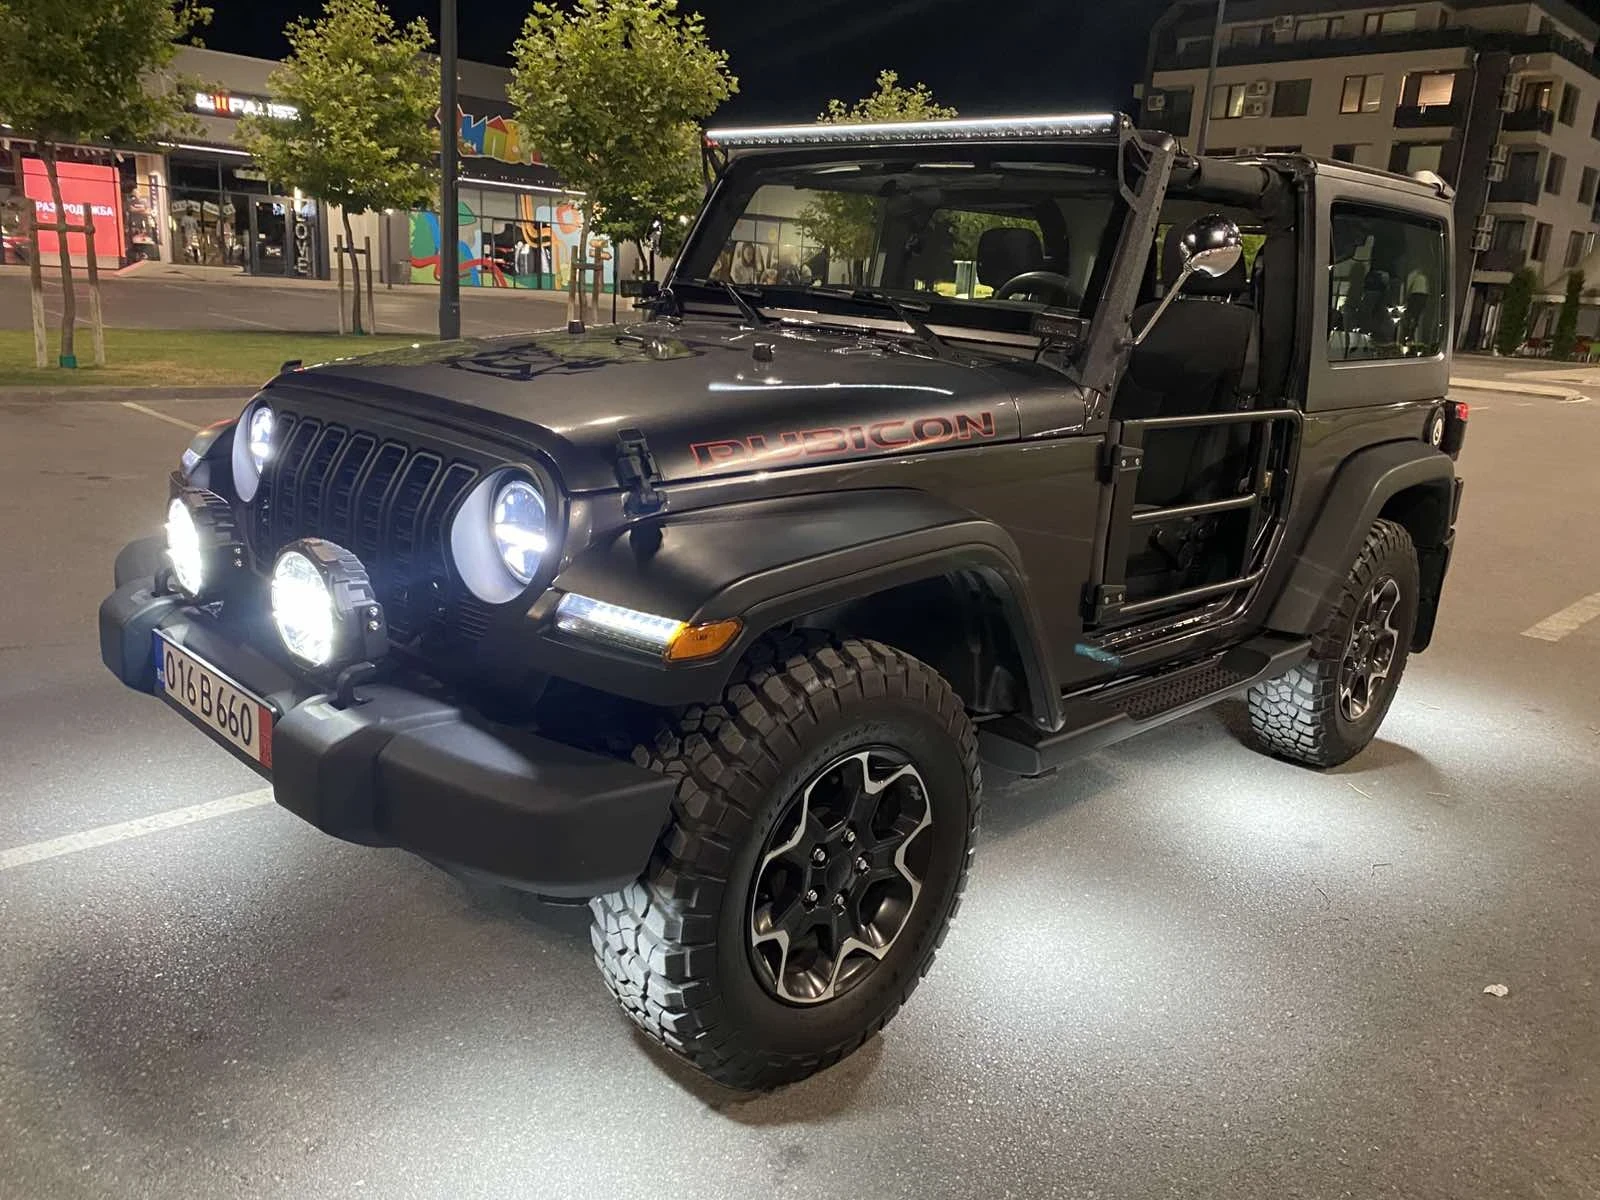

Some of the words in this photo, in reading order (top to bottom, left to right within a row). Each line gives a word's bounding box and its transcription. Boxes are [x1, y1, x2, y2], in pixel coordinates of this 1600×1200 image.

[36, 201, 114, 217] РАЗРОДЖБА
[690, 412, 996, 470] RUBICON
[165, 650, 252, 746] 016B660
